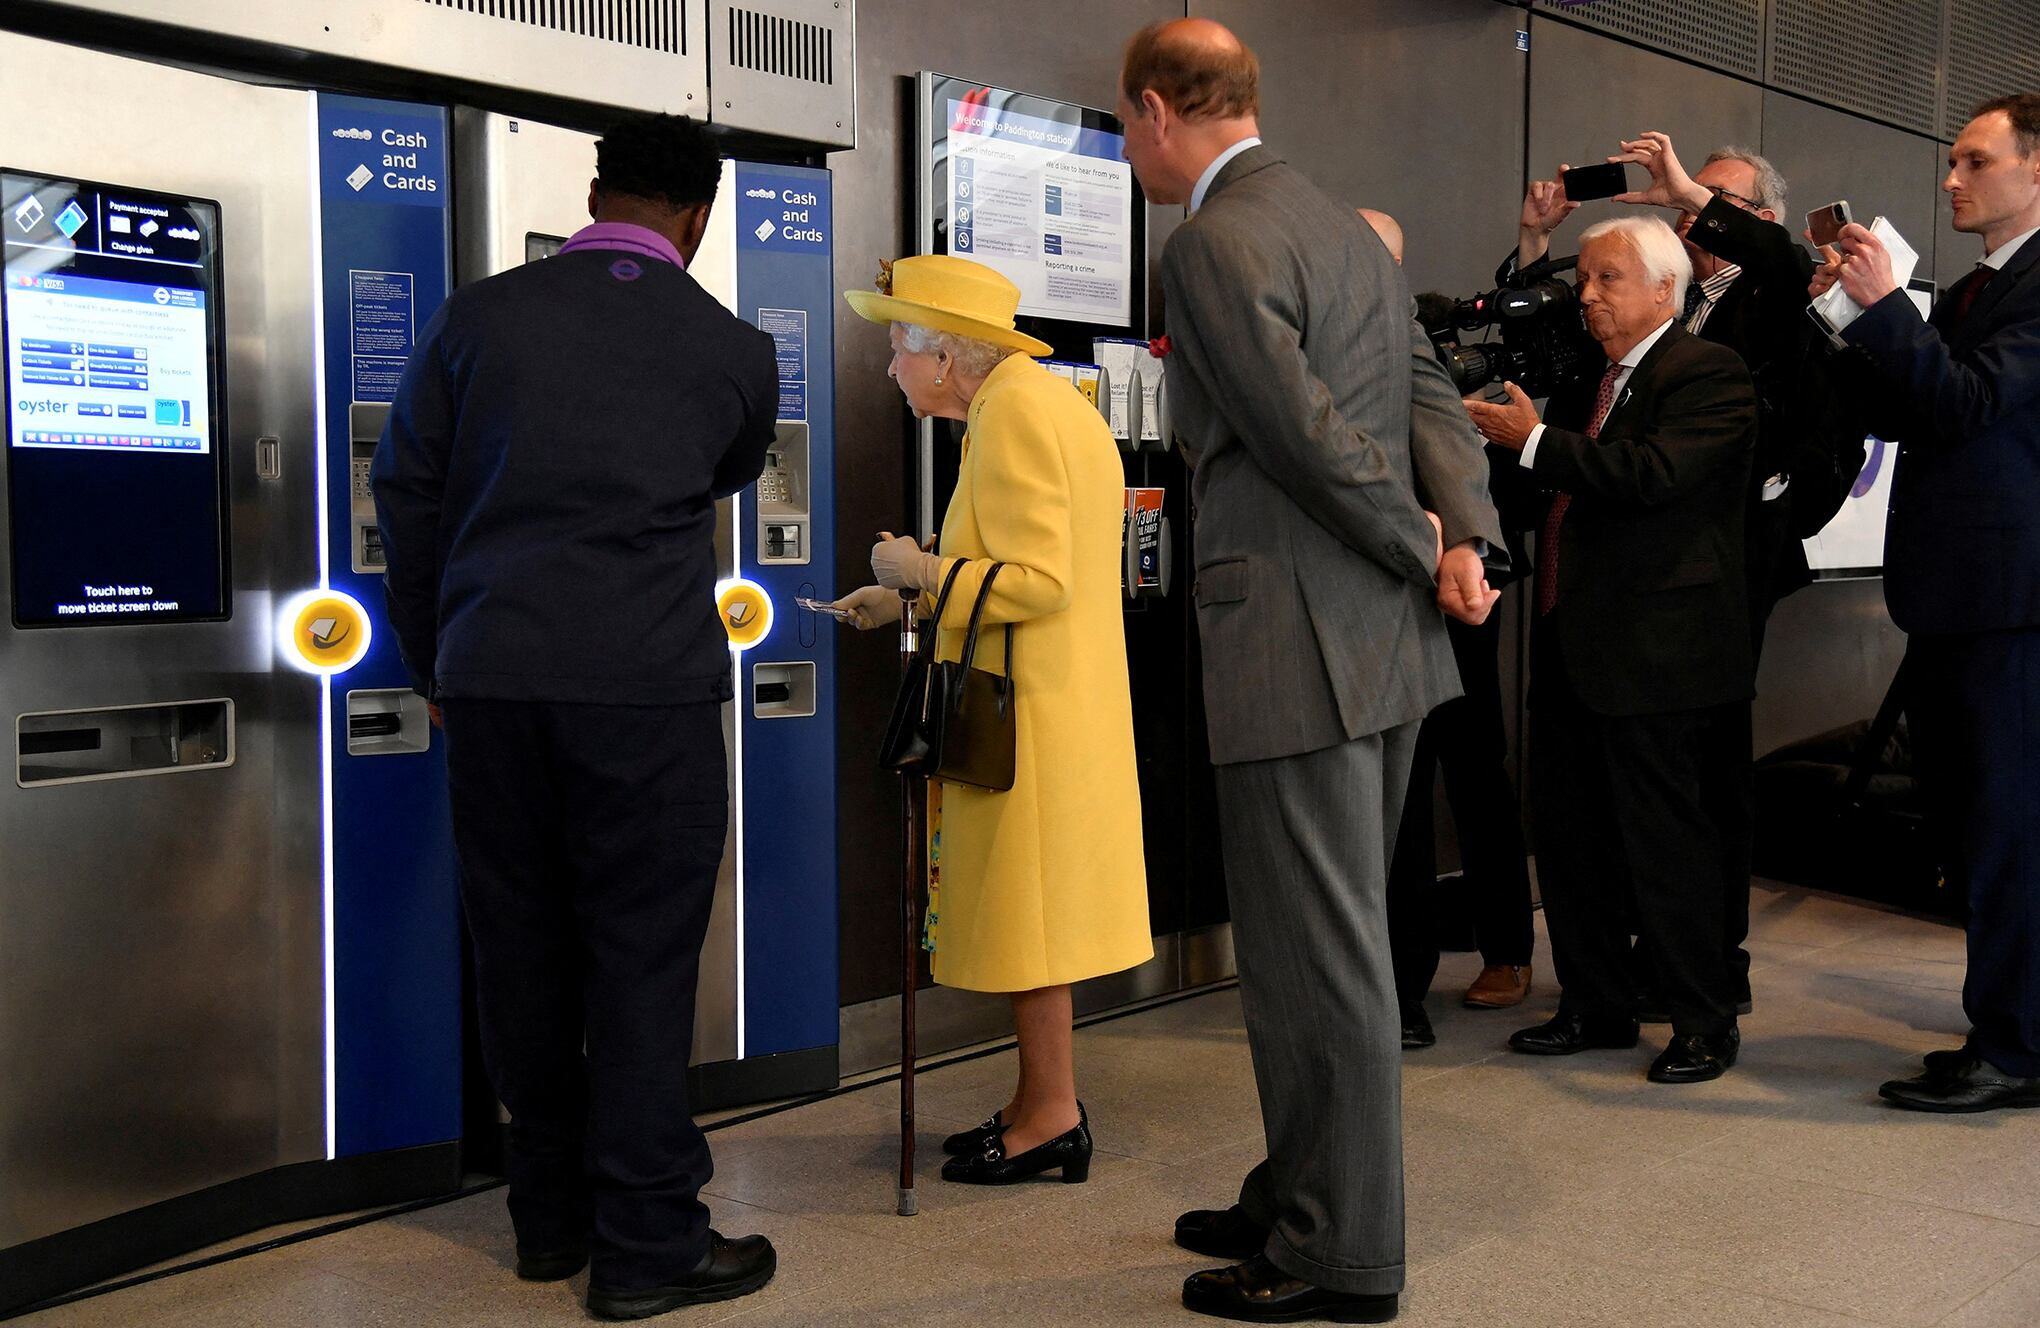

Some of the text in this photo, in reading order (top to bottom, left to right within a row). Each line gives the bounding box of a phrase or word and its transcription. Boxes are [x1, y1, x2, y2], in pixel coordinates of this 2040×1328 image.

[955, 112, 1073, 145] Welcome to Paddington station
[381, 129, 427, 148] Cash
[382, 153, 417, 169] and
[980, 147, 1016, 160] information
[1045, 160, 1060, 170] We'd
[1060, 163, 1070, 171] like
[1071, 165, 1077, 173] to
[1078, 167, 1091, 175] hear
[1092, 168, 1108, 177] from
[383, 172, 437, 192] Cards
[782, 189, 817, 206] Cash
[109, 200, 169, 218] Payment accepted
[782, 209, 809, 223] and
[782, 225, 823, 242] Cards
[111, 241, 155, 255] Change given
[1045, 260, 1074, 273] Reporting
[1079, 265, 1096, 273] crime
[46, 280, 64, 289] VISA
[19, 399, 69, 415] oyster
[1146, 508, 1160, 524] OFF
[1144, 523, 1158, 534] FARES
[85, 585, 153, 597] Touch here to
[58, 601, 178, 614] move ticket screen down
